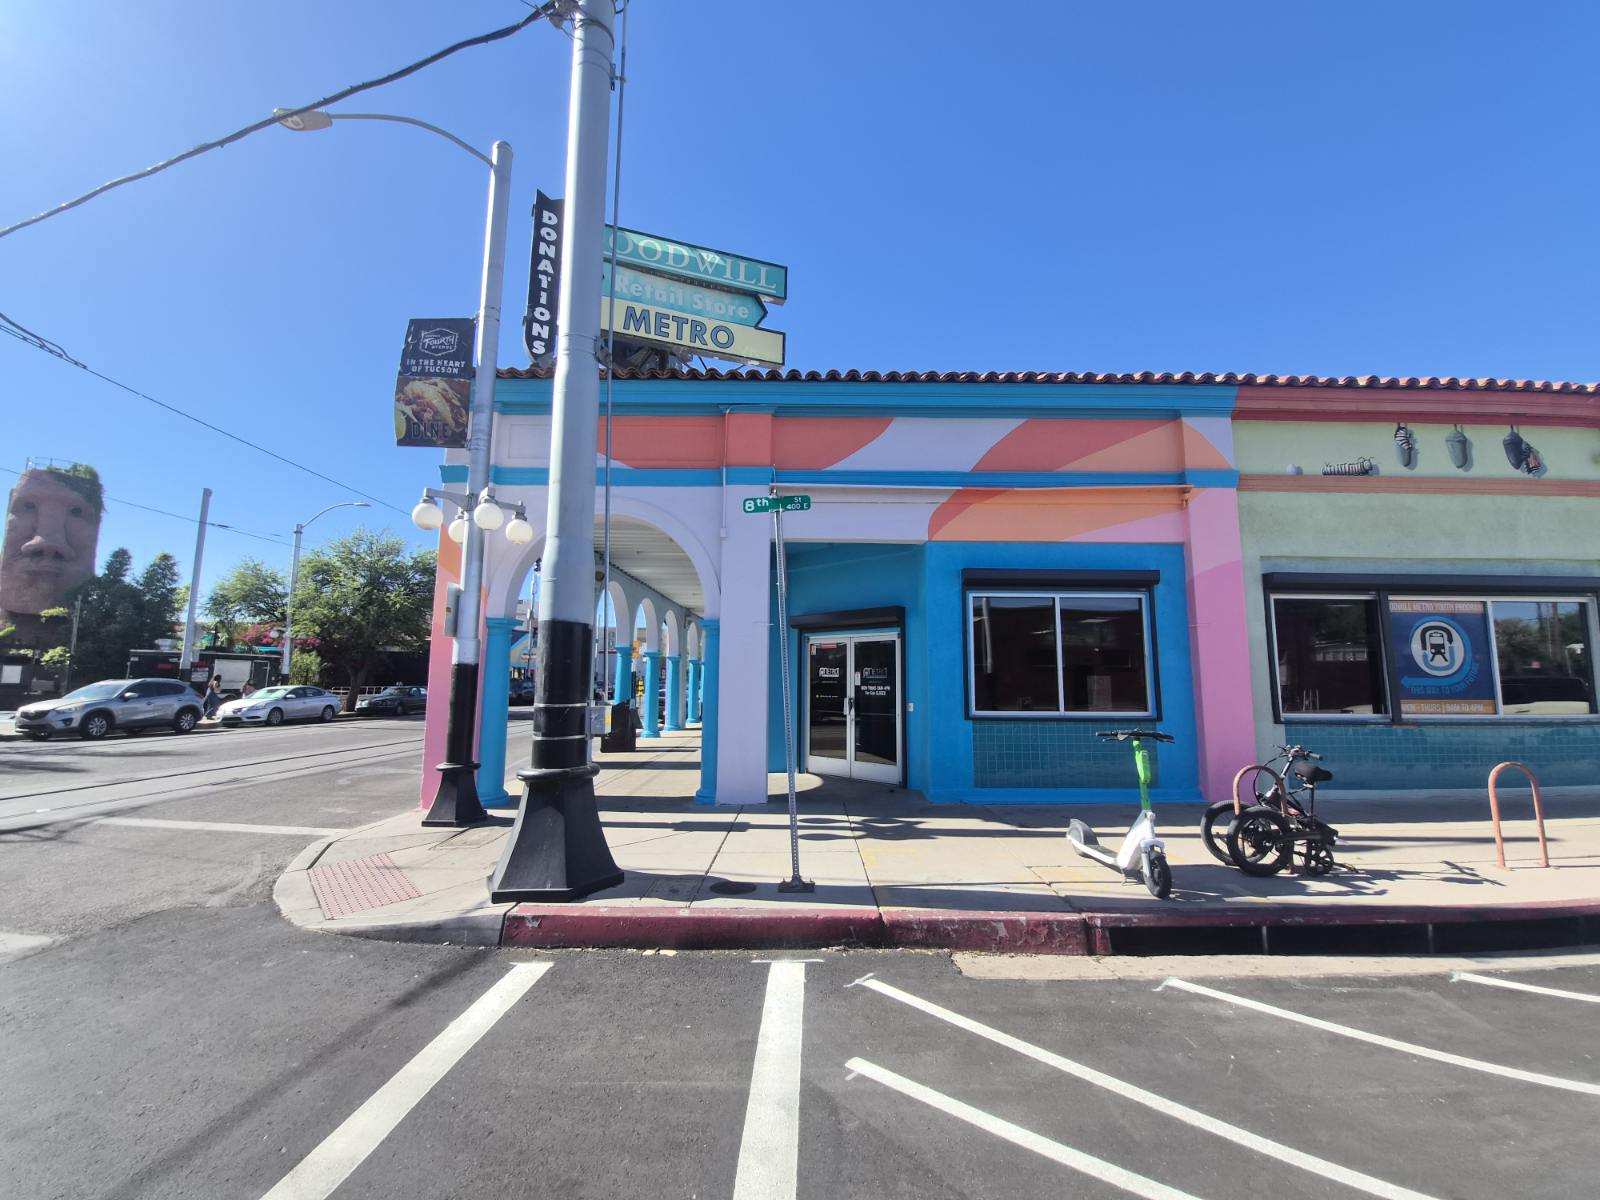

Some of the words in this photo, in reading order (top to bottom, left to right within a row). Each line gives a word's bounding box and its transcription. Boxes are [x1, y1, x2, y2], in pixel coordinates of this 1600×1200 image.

[608, 231, 777, 288] OODWILL
[531, 210, 558, 354] DONATIONS
[616, 274, 684, 306] Retail
[692, 293, 749, 319] Store
[622, 305, 735, 349] METRO
[411, 365, 423, 373] OF
[425, 365, 459, 375] TUCSON
[437, 360, 466, 368] HEART
